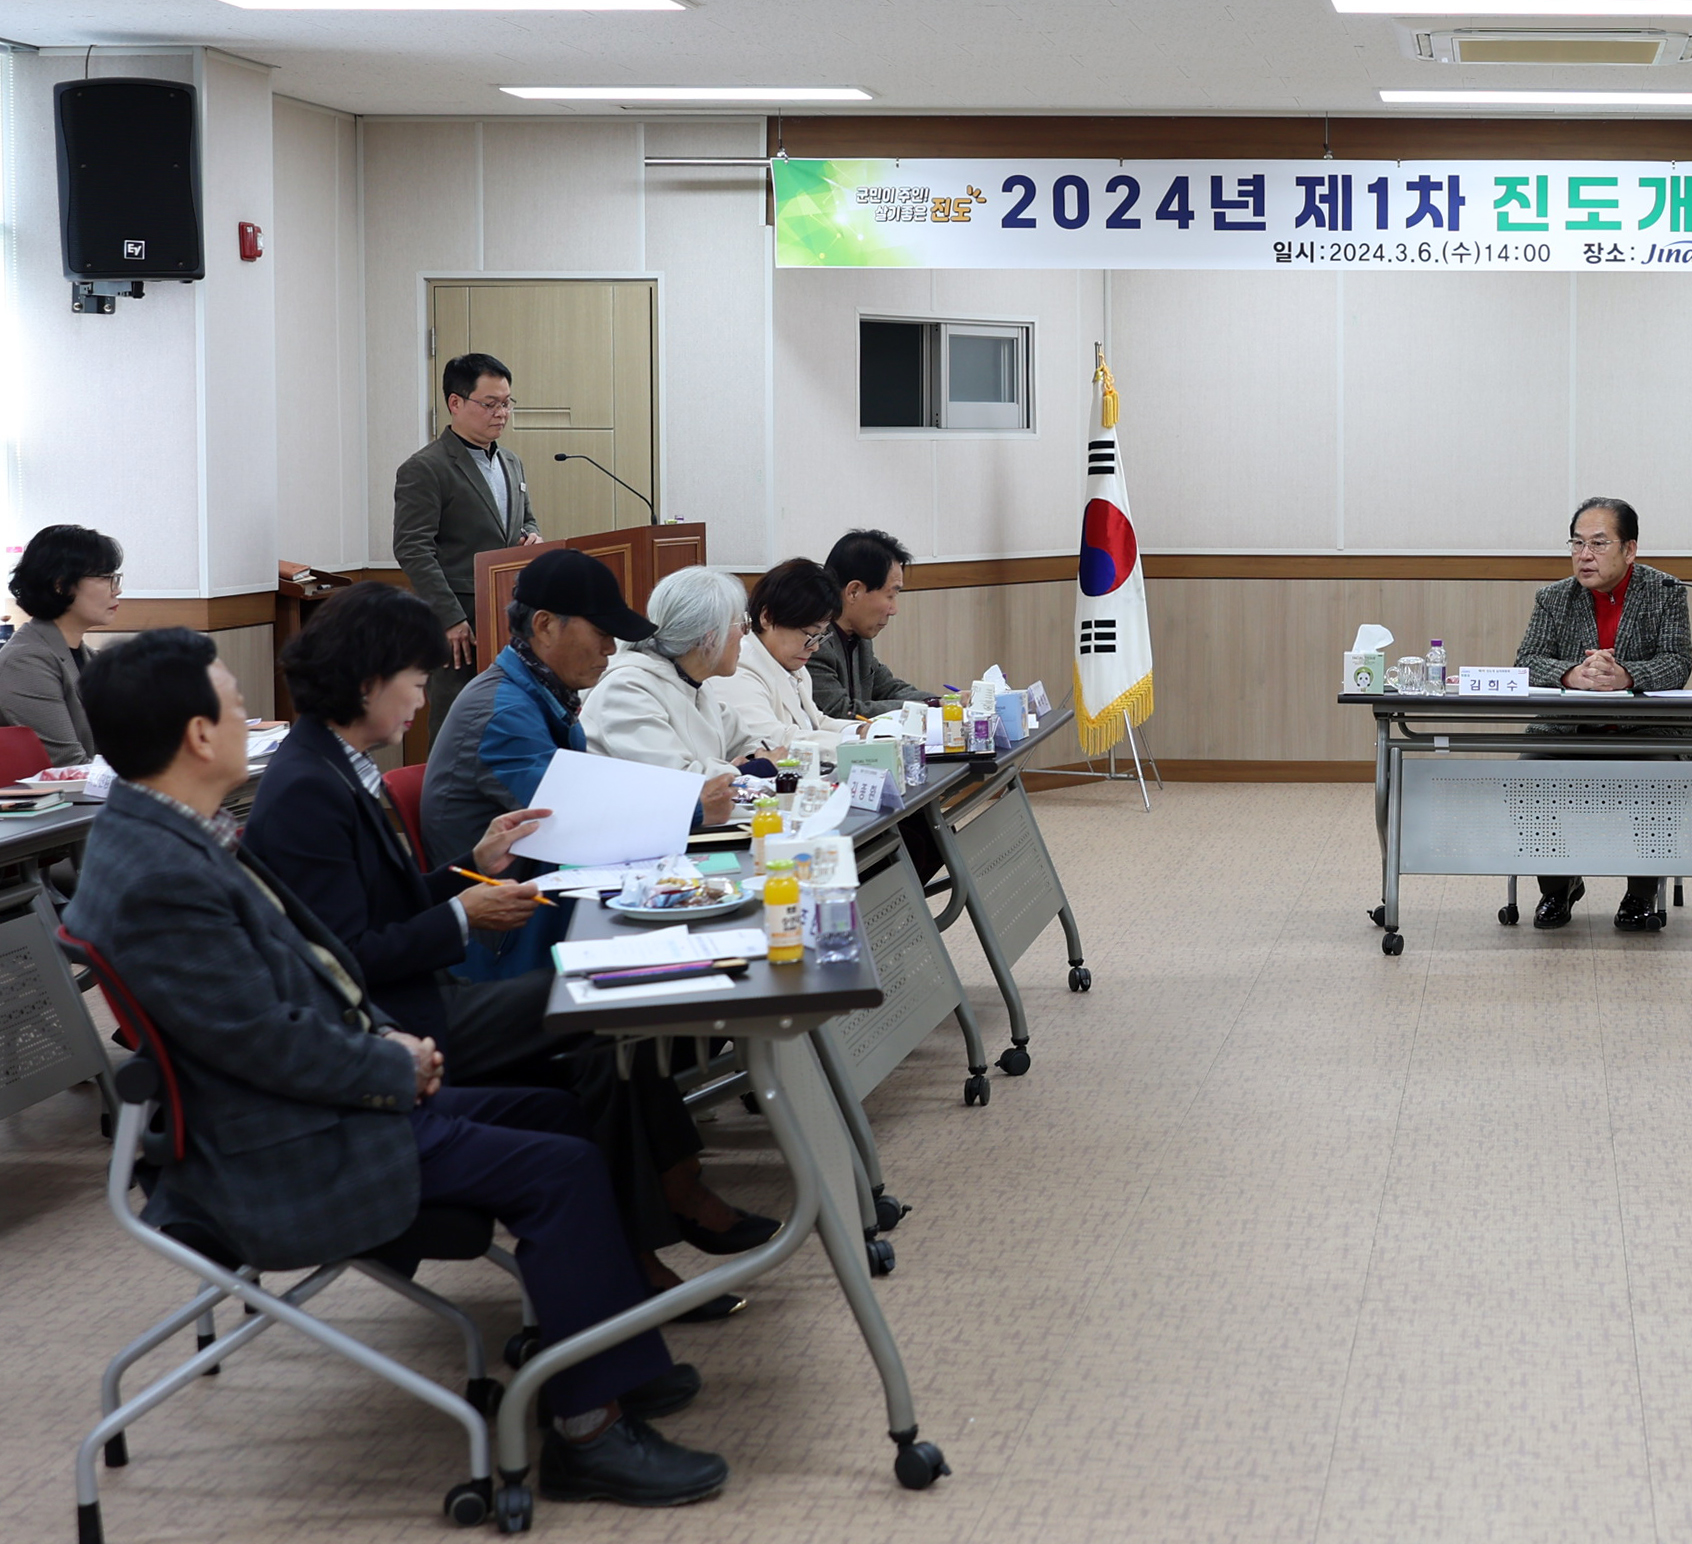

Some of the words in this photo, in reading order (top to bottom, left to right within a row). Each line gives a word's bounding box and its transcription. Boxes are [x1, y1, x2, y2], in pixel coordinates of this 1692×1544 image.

[856, 187, 897, 204] 군민이
[897, 187, 930, 204] 주인!
[1001, 174, 1267, 231] 2024년
[1294, 174, 1466, 231] 제1차
[875, 205, 928, 222] 살기좋은
[930, 197, 973, 222] 진도
[1583, 243, 1636, 264] 장소:
